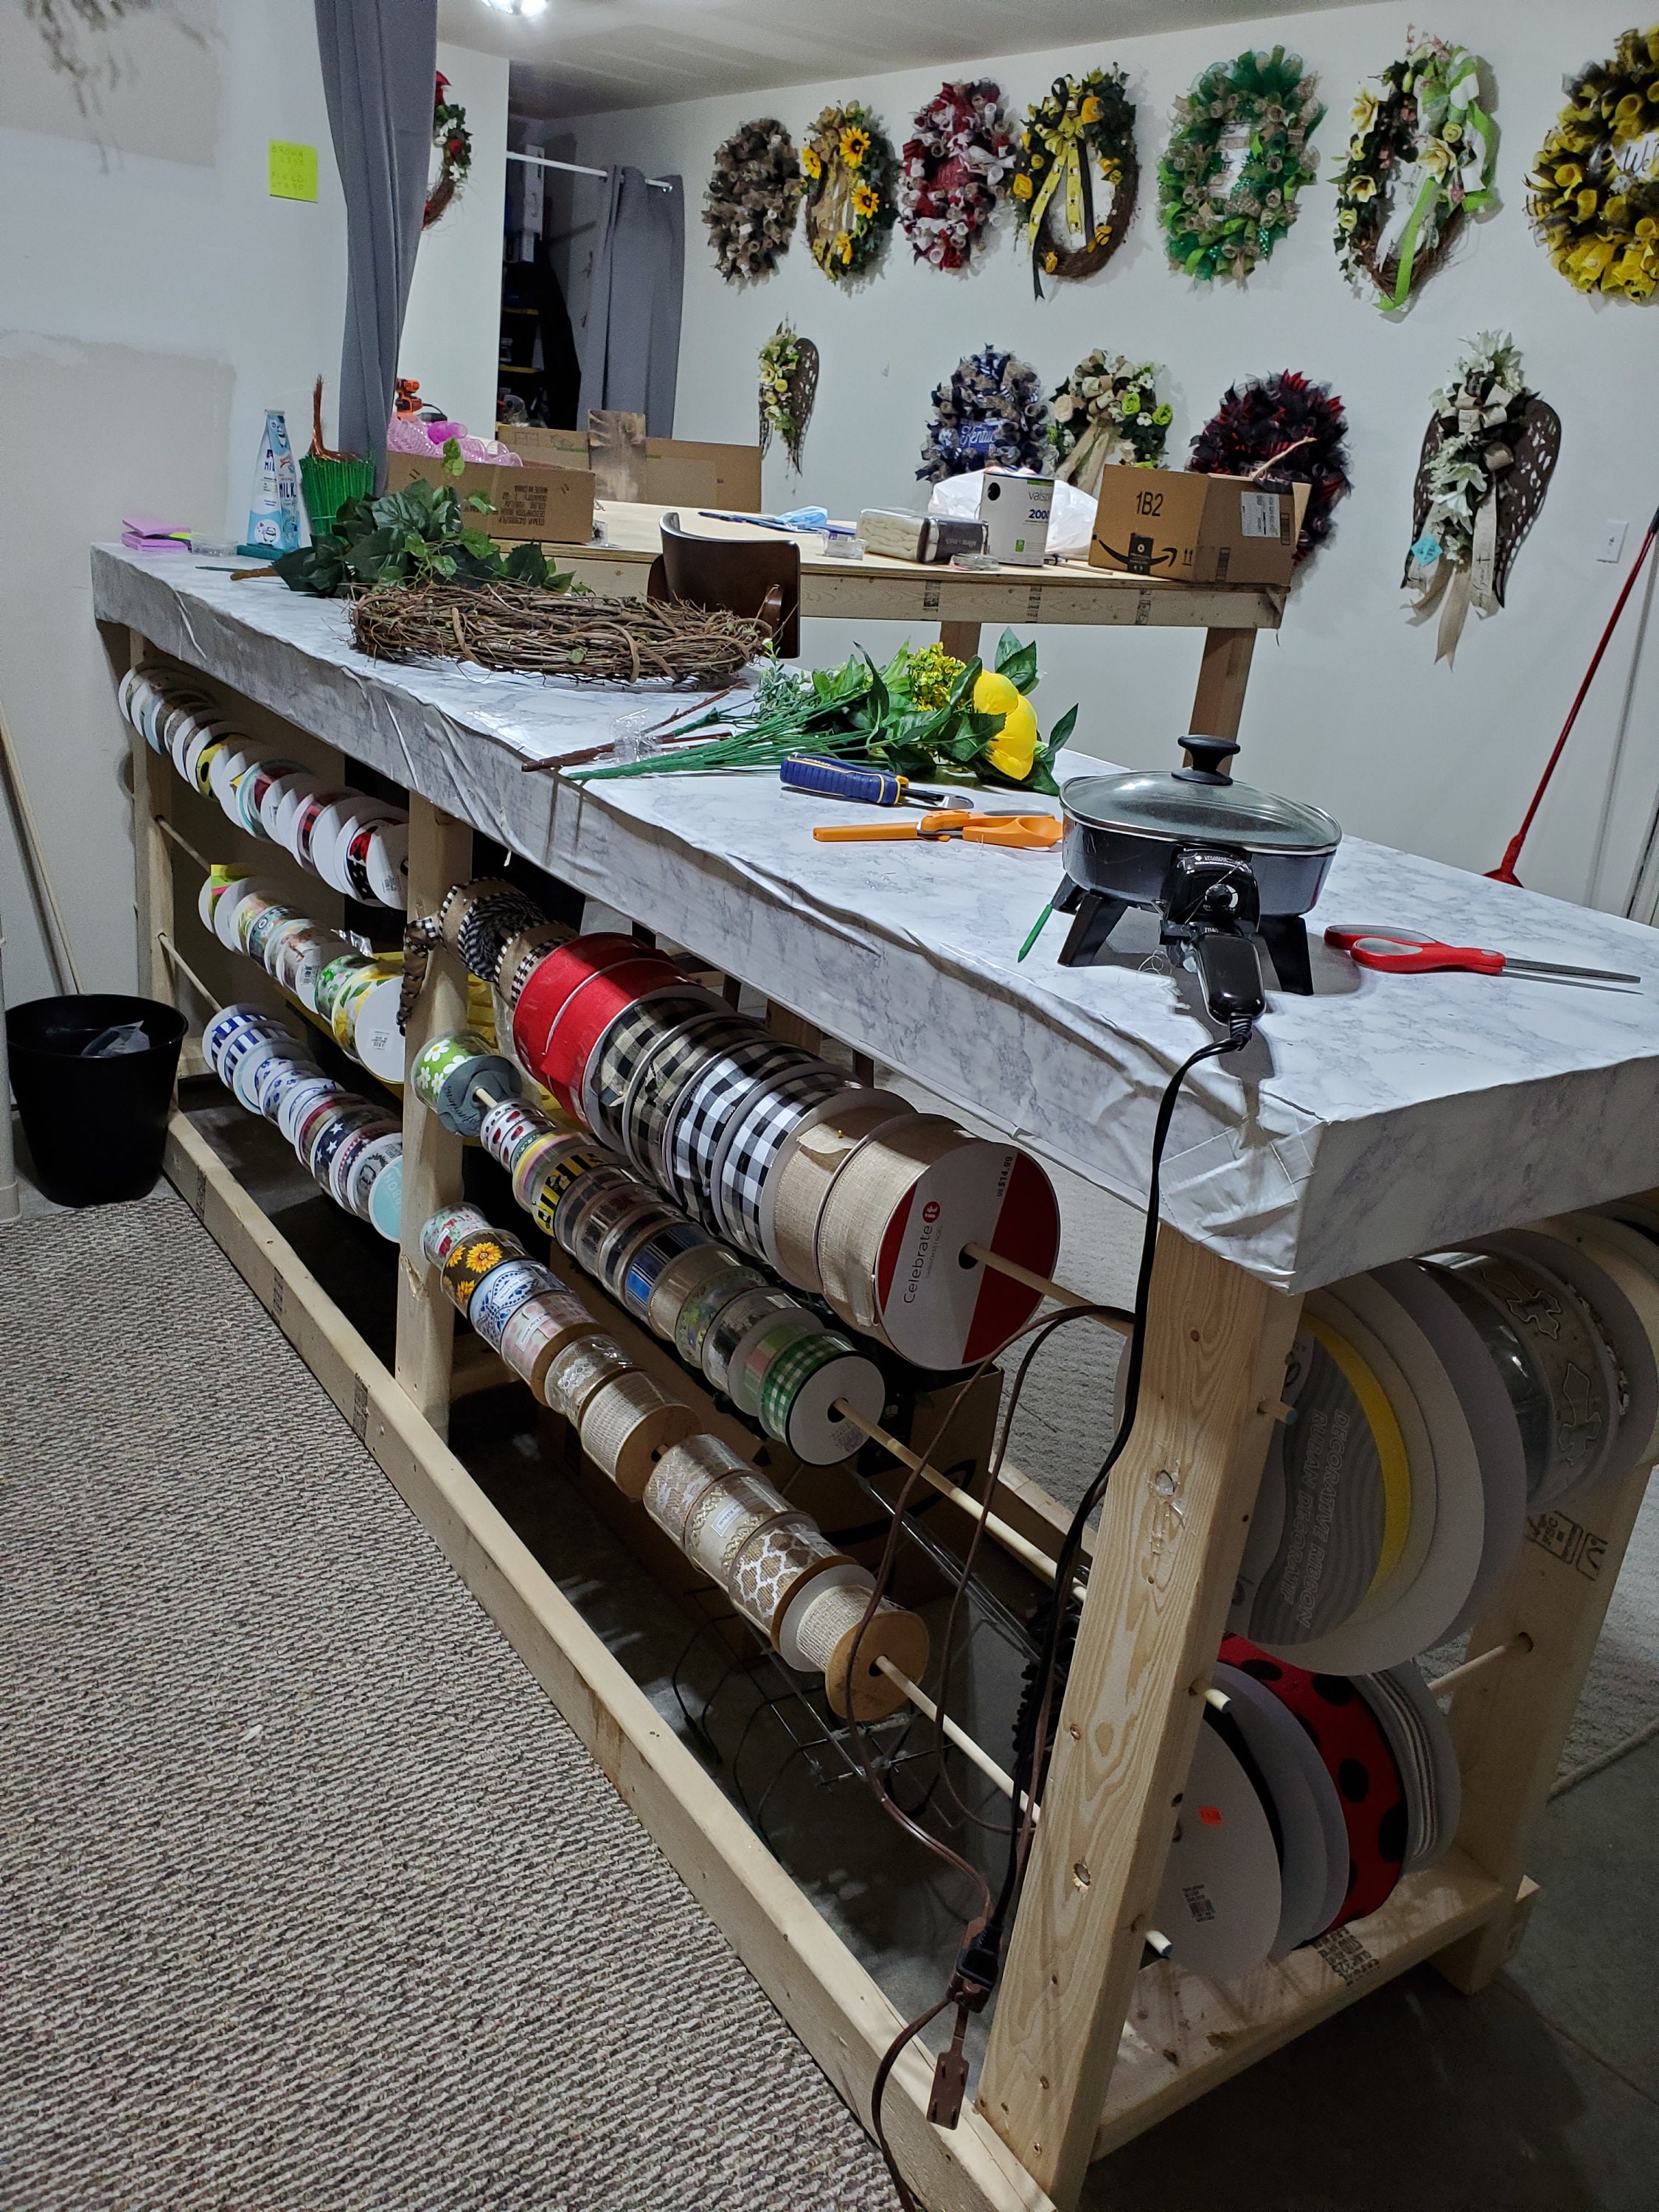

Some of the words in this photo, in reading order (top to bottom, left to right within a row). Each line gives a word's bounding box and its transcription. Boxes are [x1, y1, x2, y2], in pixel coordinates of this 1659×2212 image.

[279, 482, 296, 498] MILK
[1136, 491, 1164, 516] 1B2
[903, 1225, 933, 1304] Celebrate
[1302, 1409, 1327, 1490] RUBAN
[1313, 1409, 1350, 1541] DECORATIVE
[1281, 1490, 1313, 1604] DECORATIF
[1296, 1543, 1326, 1628] RIBBON
